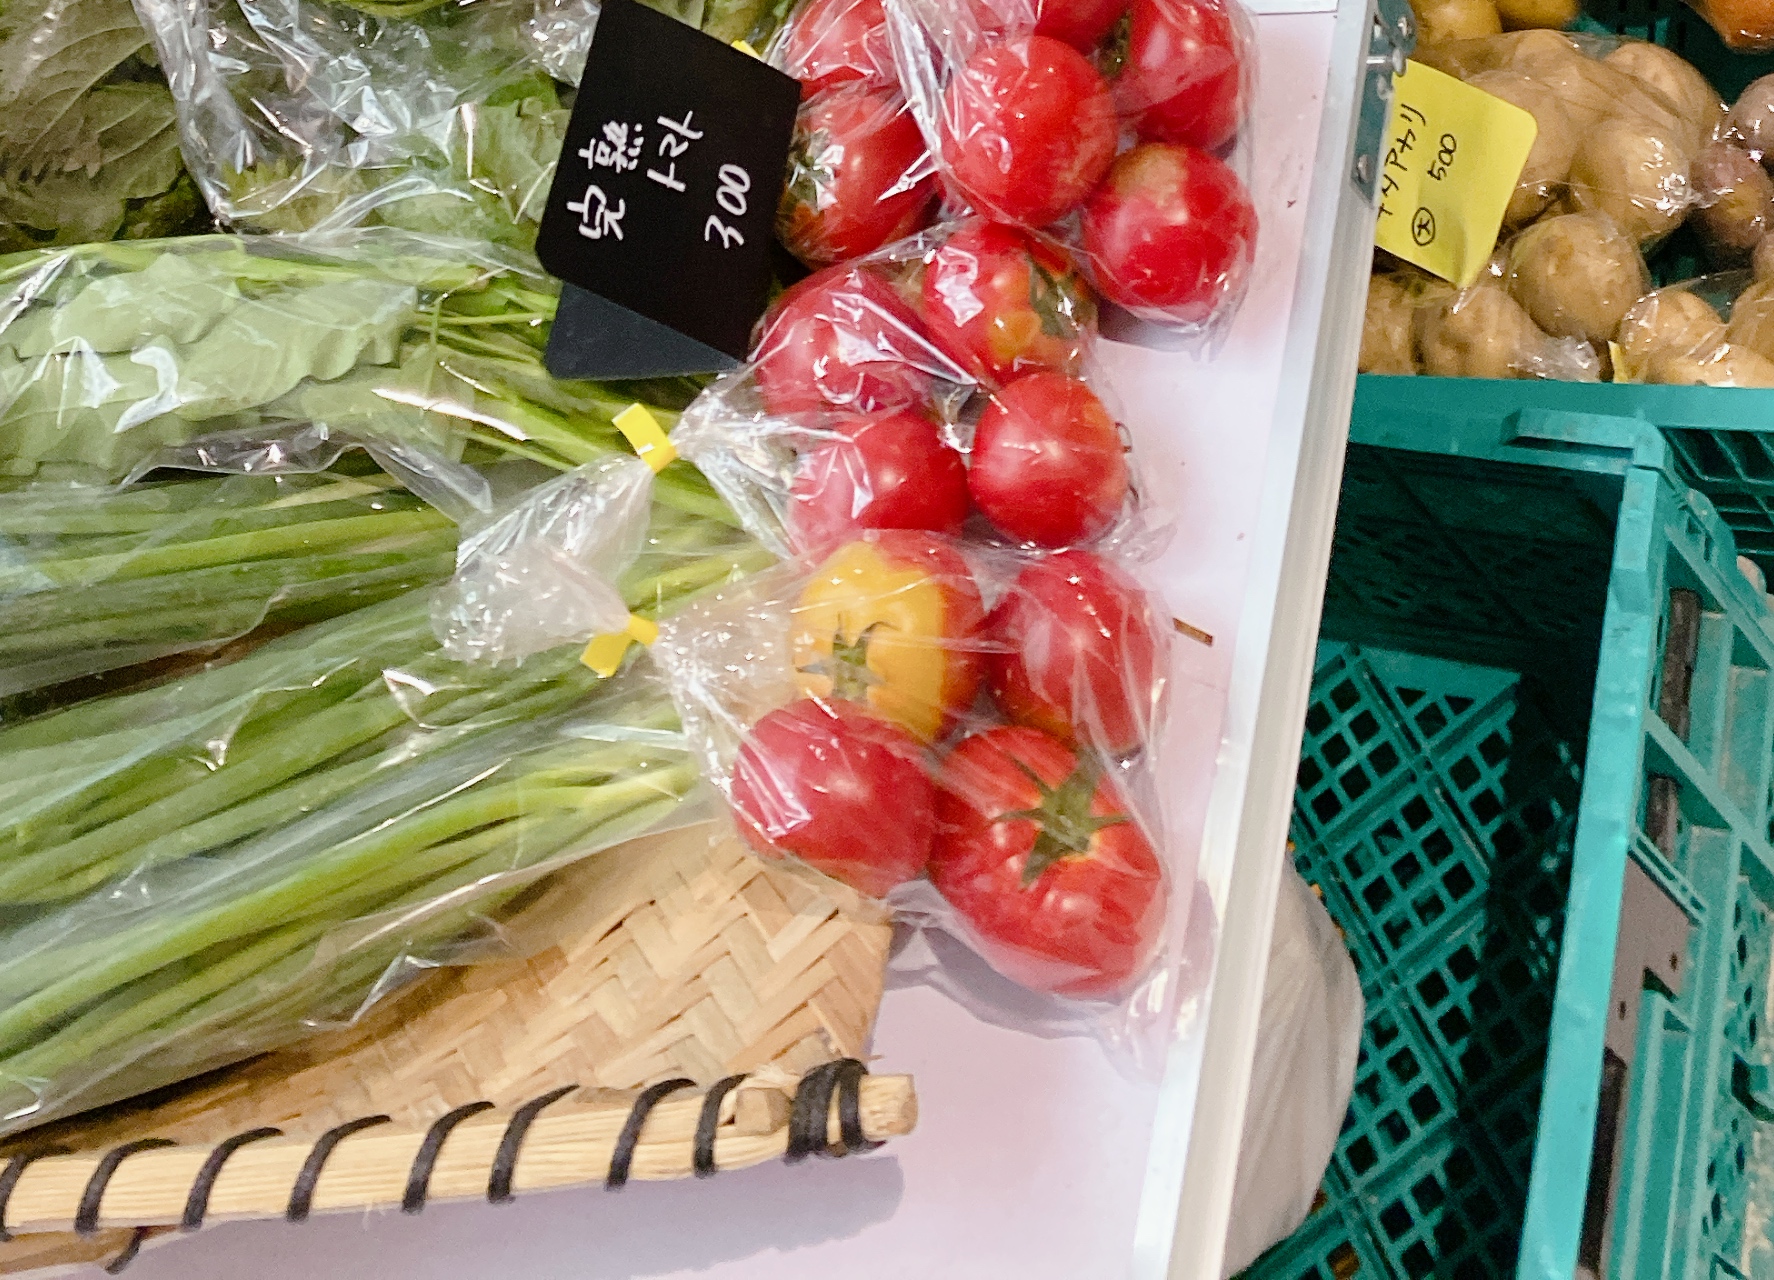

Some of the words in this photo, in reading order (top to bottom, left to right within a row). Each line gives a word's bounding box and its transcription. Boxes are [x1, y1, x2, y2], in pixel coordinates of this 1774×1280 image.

[566, 120, 645, 242] 完熟
[647, 110, 704, 193] トマト
[1427, 133, 1457, 181] 500
[704, 163, 751, 249] 300
